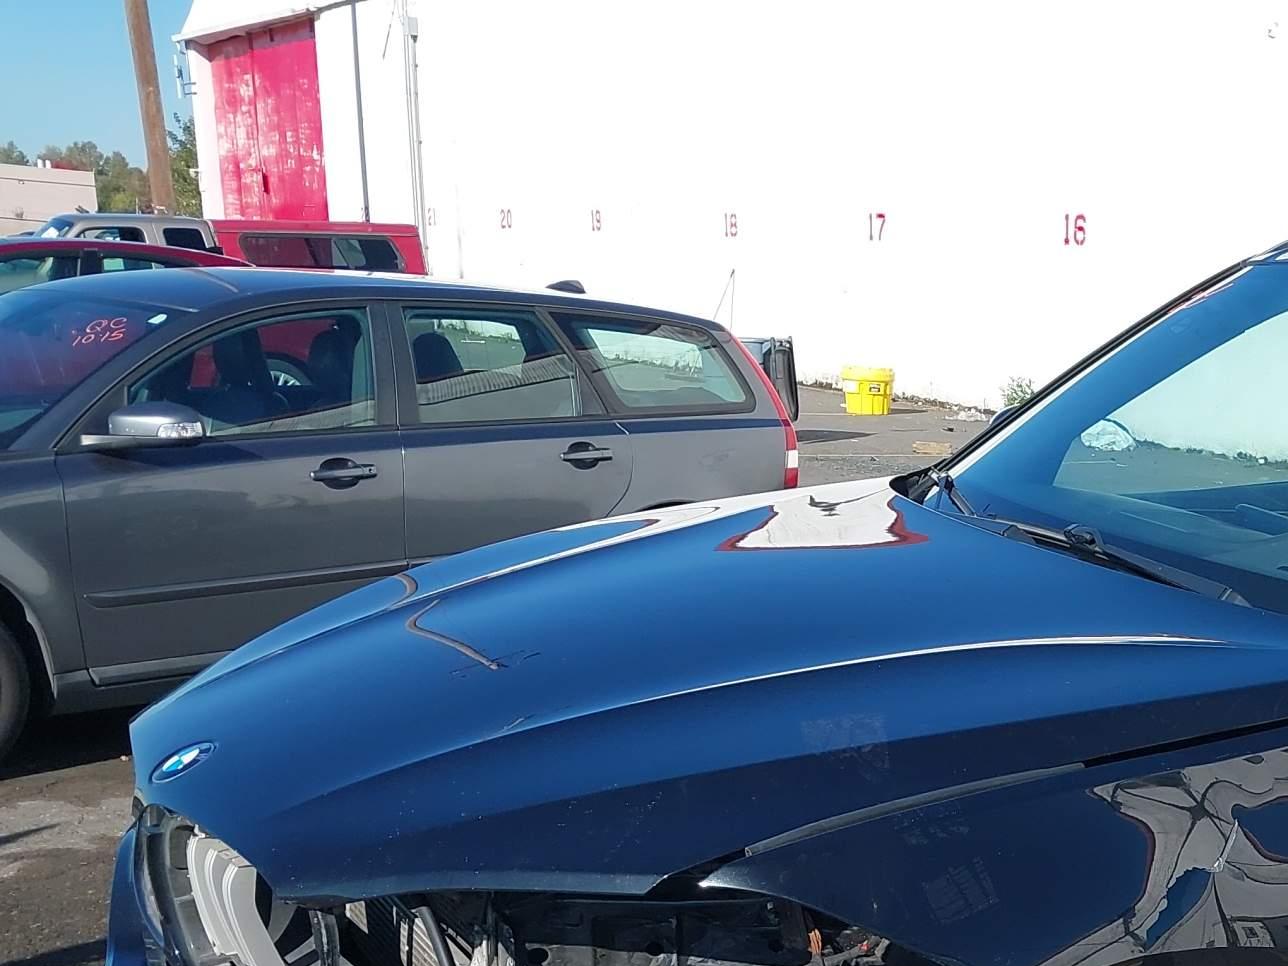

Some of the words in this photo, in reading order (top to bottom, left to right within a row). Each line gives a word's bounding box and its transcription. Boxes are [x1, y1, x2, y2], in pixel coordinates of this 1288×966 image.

[499, 209, 512, 229] 20
[591, 210, 602, 231] 19
[724, 213, 738, 237] 18
[868, 213, 886, 241] 17
[1064, 213, 1087, 246] 16
